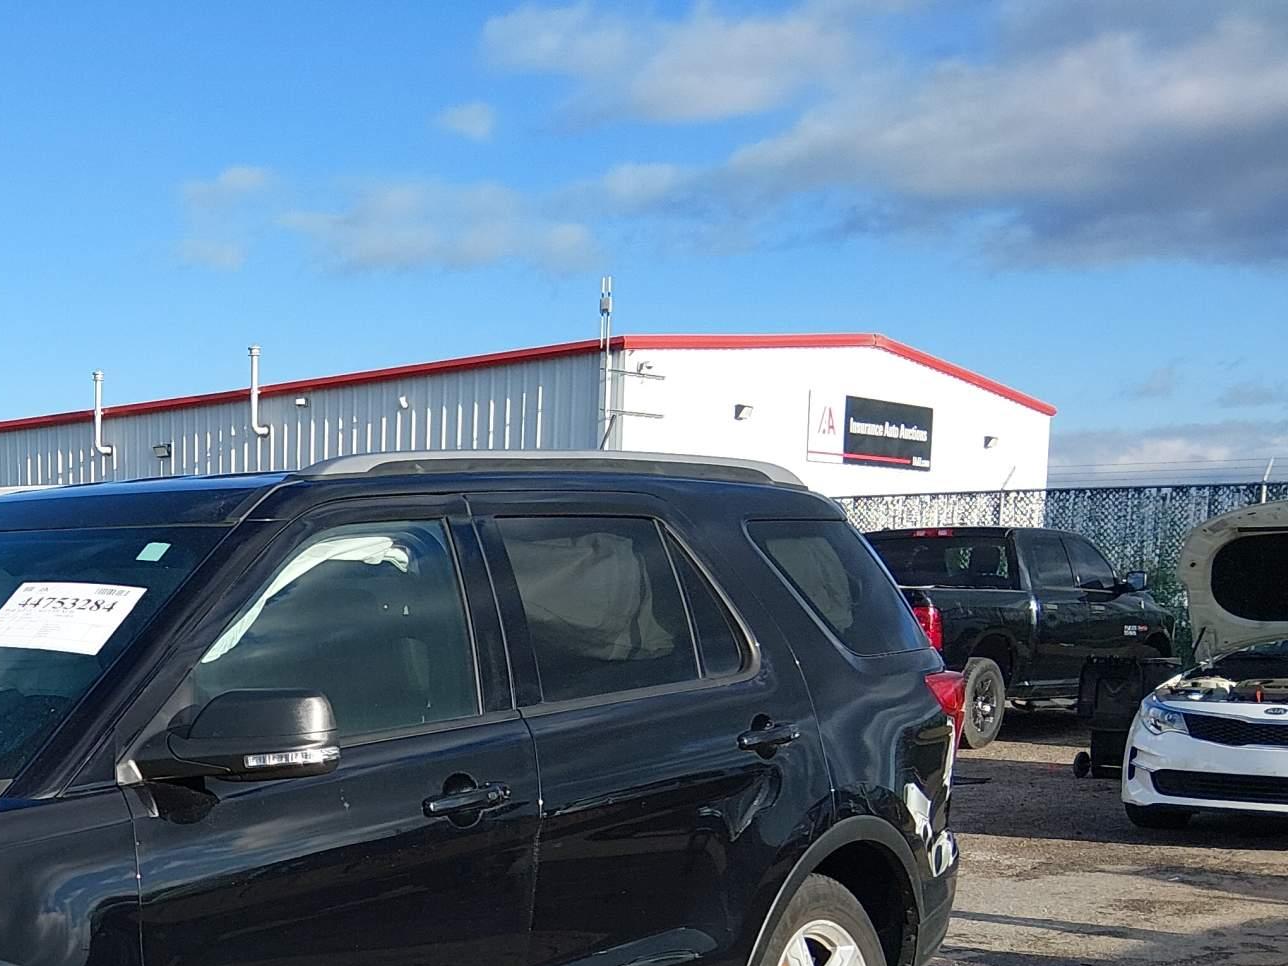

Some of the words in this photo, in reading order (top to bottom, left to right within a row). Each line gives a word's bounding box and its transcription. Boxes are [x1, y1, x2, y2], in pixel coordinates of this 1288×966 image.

[849, 416, 884, 437] Insurance
[883, 421, 899, 438] Auto
[899, 423, 928, 442] Auctions
[18, 597, 118, 612] 44753284
